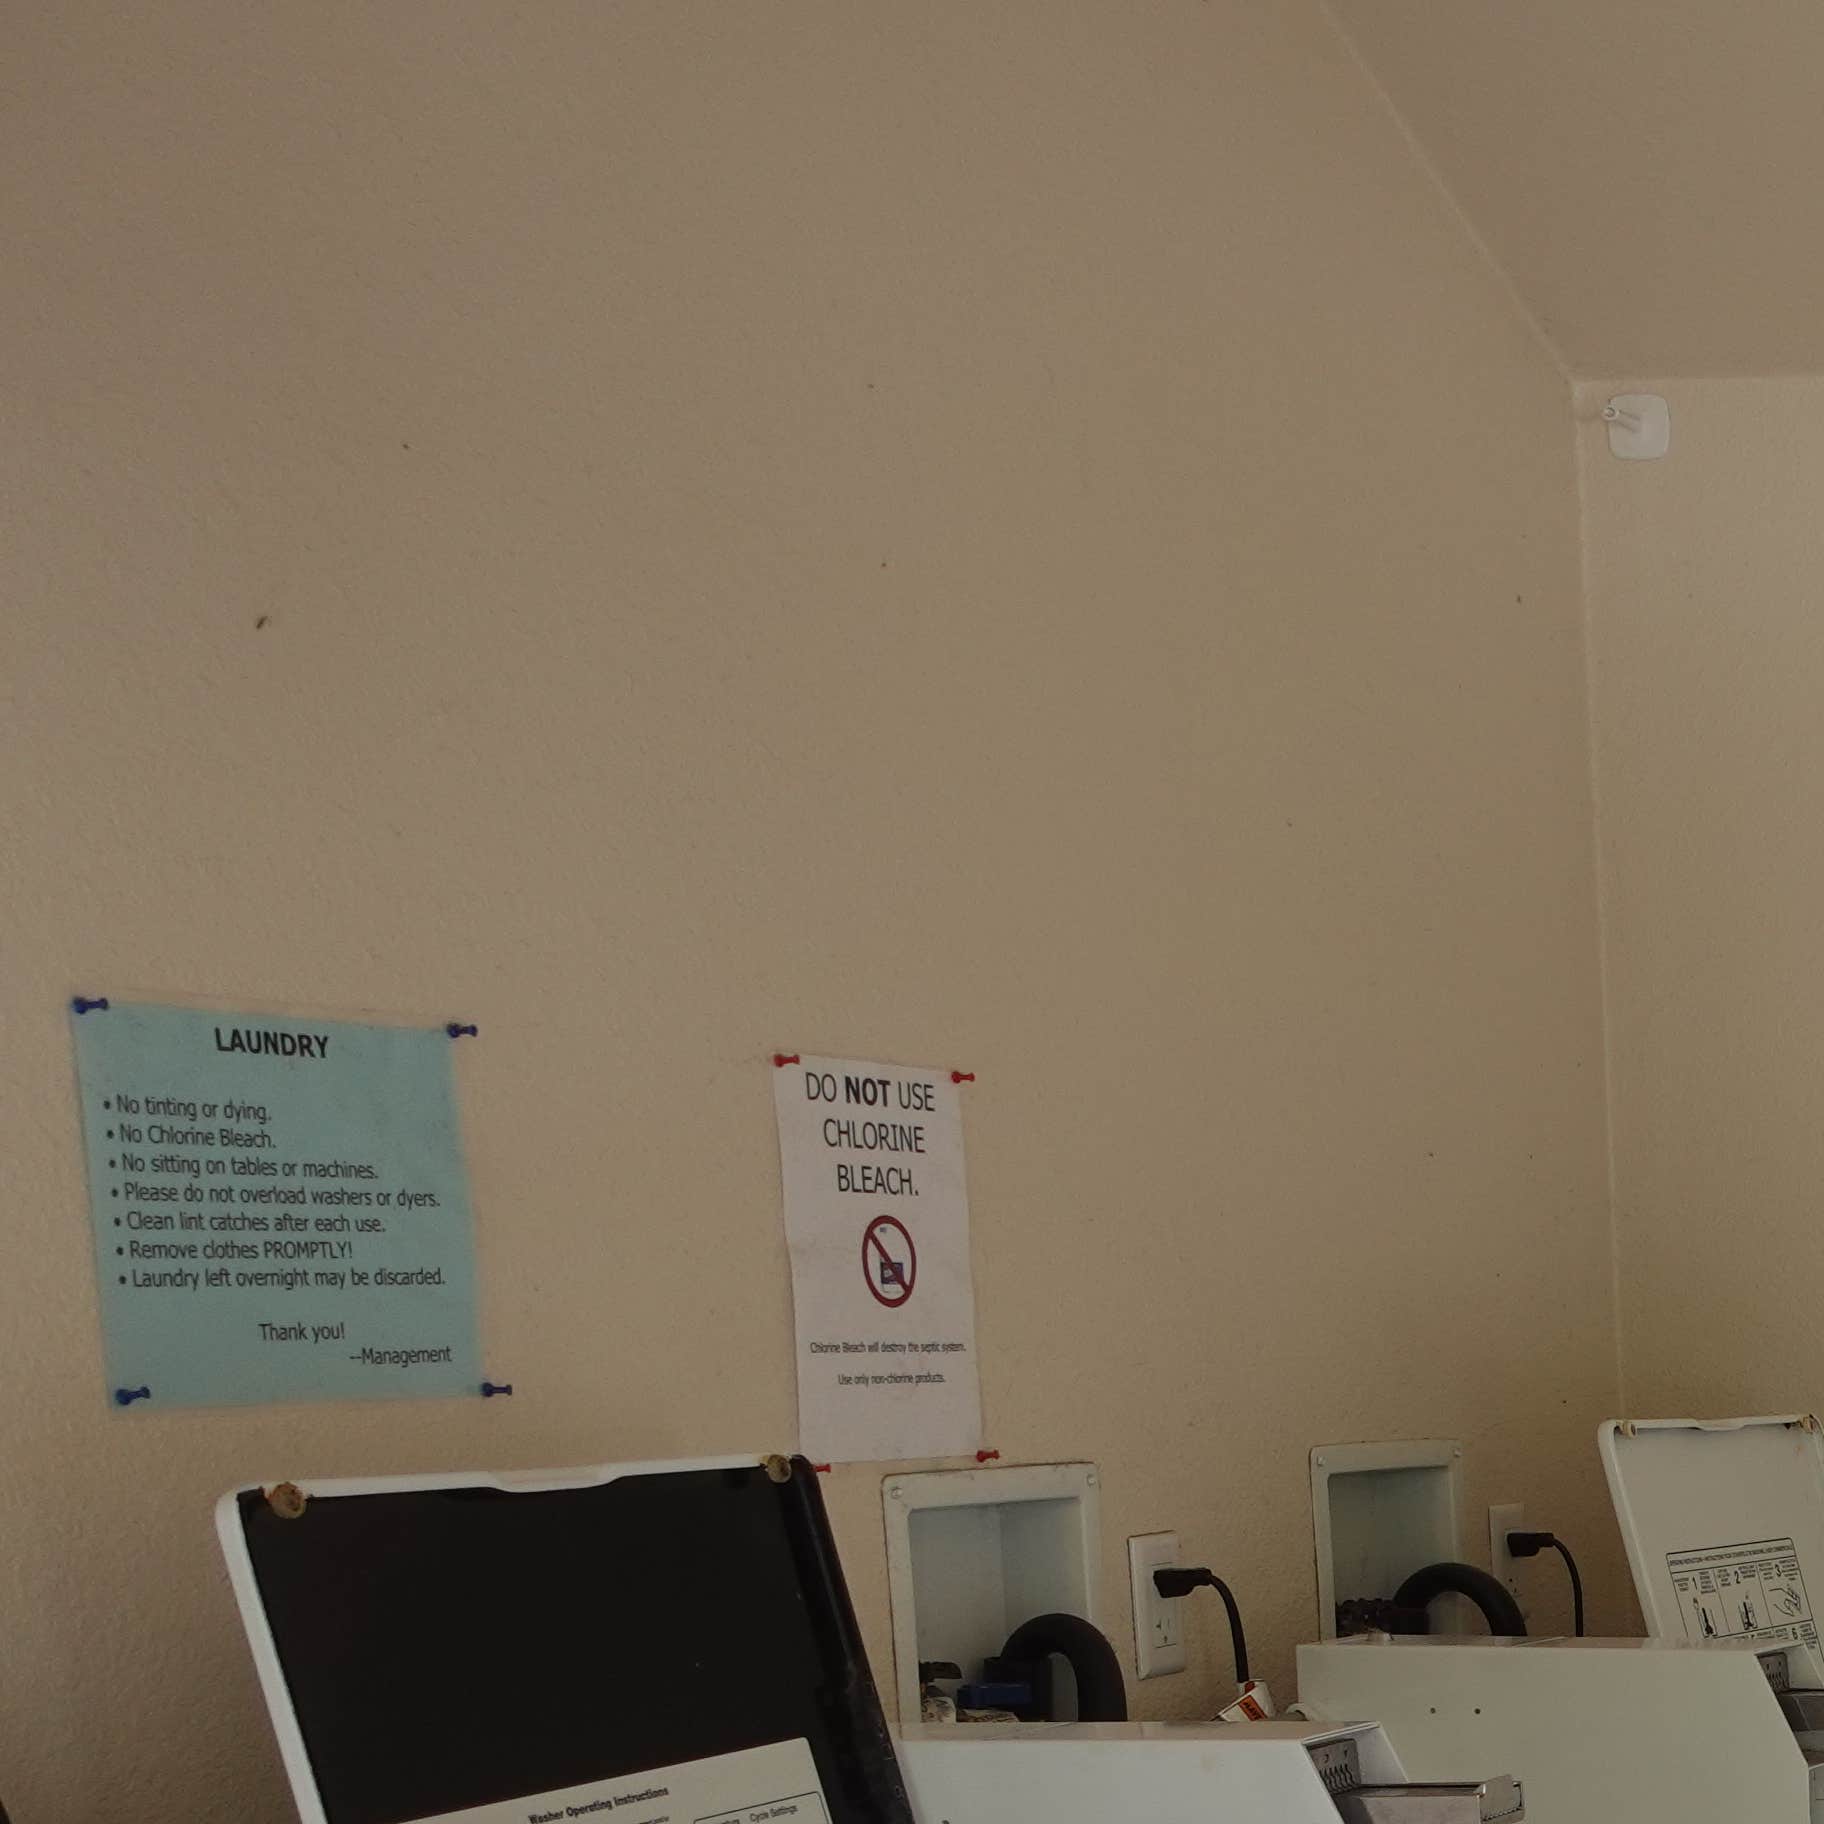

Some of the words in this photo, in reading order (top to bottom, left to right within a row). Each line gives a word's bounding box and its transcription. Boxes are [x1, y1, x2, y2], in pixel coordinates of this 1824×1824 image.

[214, 1027, 329, 1058] LAUNDRY
[806, 1072, 837, 1102] DO
[845, 1076, 891, 1106] NOT
[898, 1081, 935, 1112] USE
[117, 1096, 140, 1114] No
[144, 1097, 196, 1121] tinting
[202, 1104, 217, 1117] or
[224, 1102, 271, 1123] dying.
[120, 1125, 143, 1142] No
[148, 1126, 214, 1146] Chlorine
[221, 1129, 276, 1148] Bleach.
[823, 1118, 925, 1153] CHLORINE
[122, 1154, 145, 1172] No
[151, 1155, 199, 1177] sitting
[206, 1161, 225, 1174] on
[231, 1157, 277, 1176] tables
[282, 1164, 297, 1176] or
[303, 1160, 378, 1179] machines.
[837, 1165, 919, 1196] BLEACH.
[125, 1183, 178, 1201] Please
[184, 1184, 203, 1201] do
[210, 1187, 234, 1202] not
[240, 1187, 305, 1205] overload
[311, 1189, 371, 1206] washers
[377, 1193, 390, 1205] or
[396, 1189, 440, 1210] dyers.
[127, 1213, 174, 1230] Clean
[180, 1213, 204, 1230] lint
[210, 1214, 268, 1231] catches
[274, 1214, 309, 1232] after
[315, 1216, 350, 1232] each
[355, 1218, 385, 1232] use.
[130, 1242, 198, 1259] Remove
[203, 1242, 258, 1259] clothes
[264, 1242, 352, 1259] PROMPTLY!
[133, 1270, 198, 1290] Laundry
[205, 1268, 231, 1287] left
[236, 1268, 309, 1290] overnight
[315, 1271, 345, 1289] may
[352, 1269, 368, 1285] be
[374, 1267, 444, 1286] discarded.
[258, 1323, 307, 1340] Thank
[312, 1324, 344, 1343] you!
[810, 1342, 840, 1353] Chlorine
[843, 1342, 865, 1353] Bleach
[881, 1342, 906, 1355] destroy
[908, 1342, 919, 1352] the
[838, 1374, 852, 1385] Use
[854, 1374, 869, 1387] only
[871, 1373, 913, 1385] non-chlorine
[1734, 1571, 1741, 1584] 2
[1775, 1564, 1782, 1577] 3
[566, 1800, 613, 1818] Operating
[613, 1788, 669, 1806] Instructions
